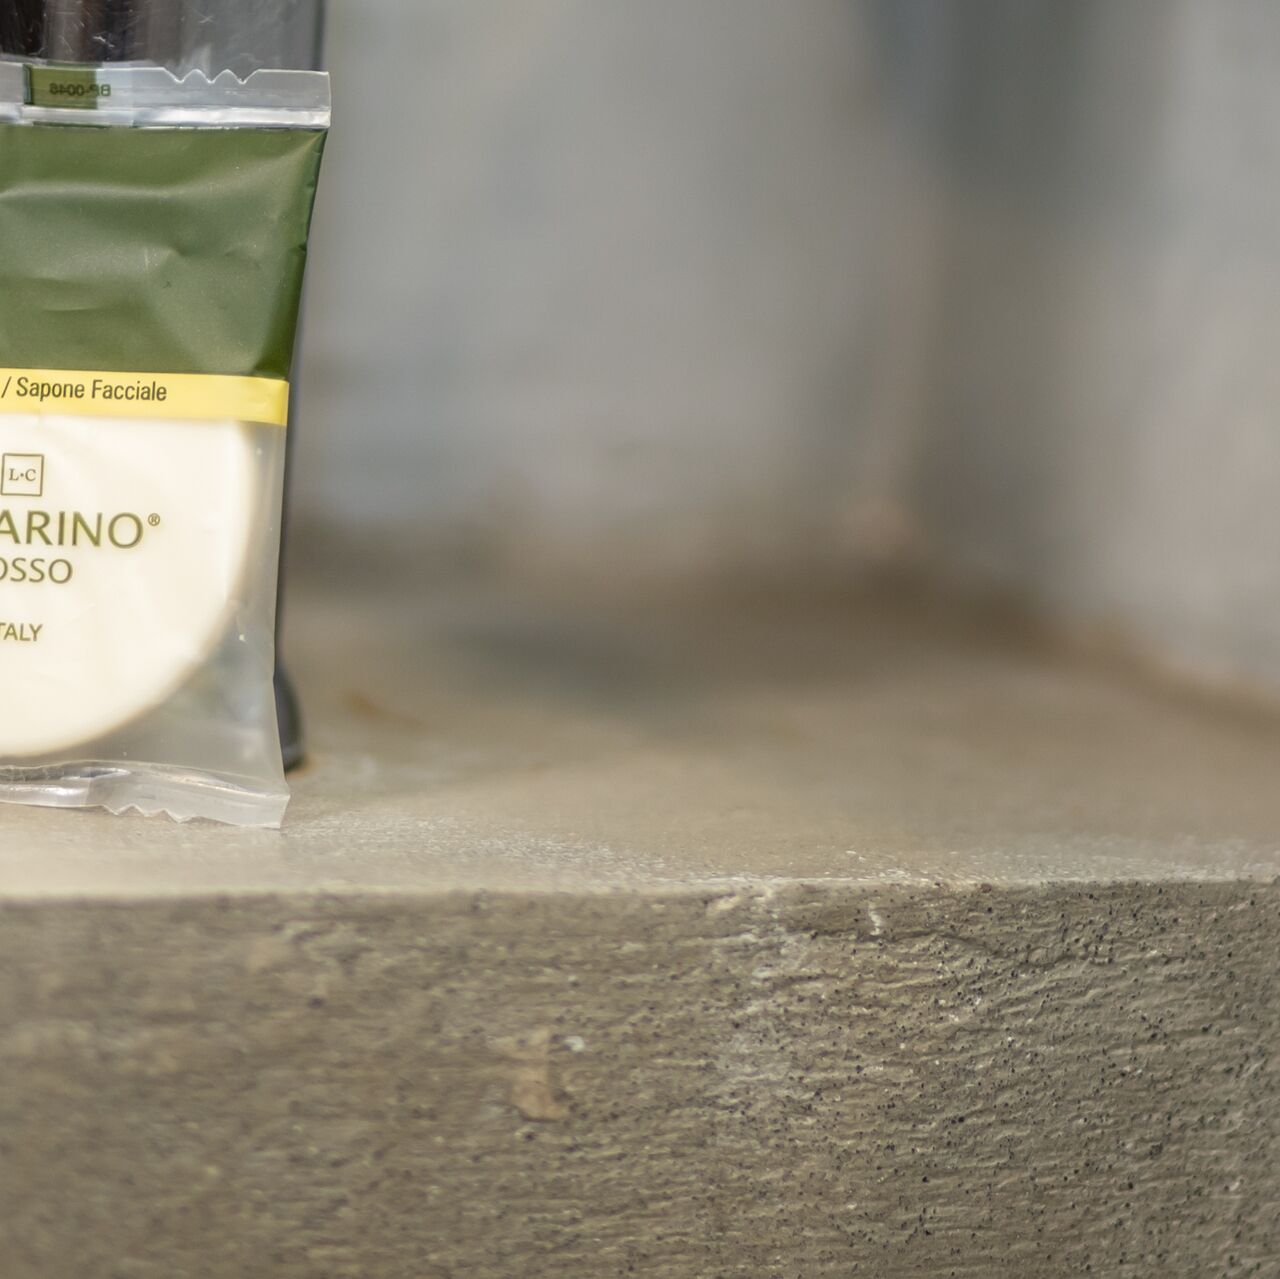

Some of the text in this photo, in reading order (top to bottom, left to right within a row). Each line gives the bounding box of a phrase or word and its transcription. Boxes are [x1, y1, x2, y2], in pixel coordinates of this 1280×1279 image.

[1, 376, 12, 398] /
[16, 377, 85, 402] Sapone
[91, 380, 167, 401] Facciale
